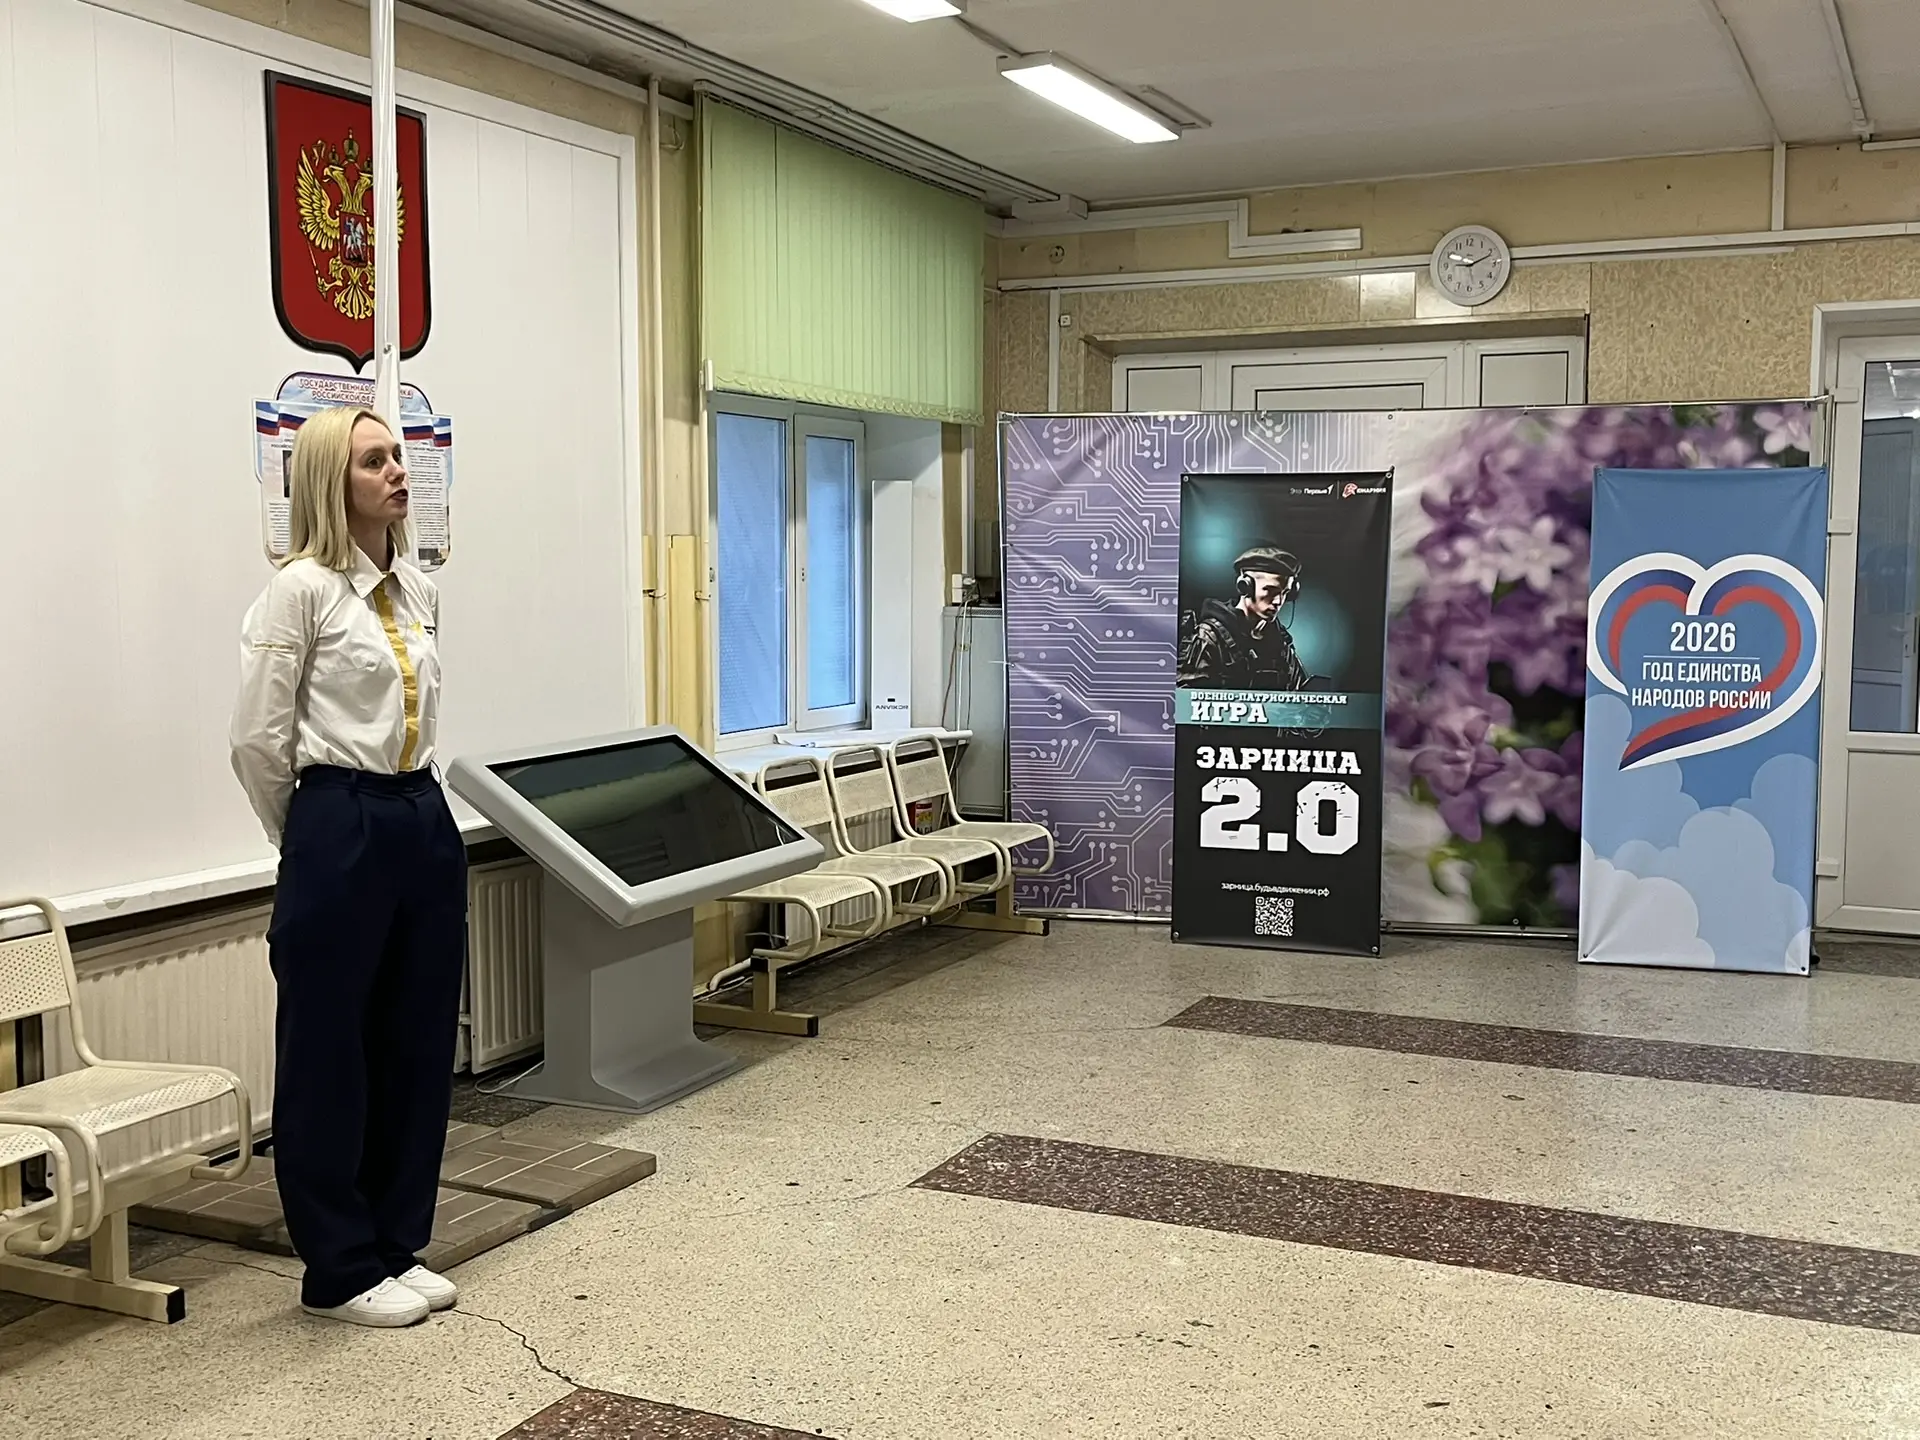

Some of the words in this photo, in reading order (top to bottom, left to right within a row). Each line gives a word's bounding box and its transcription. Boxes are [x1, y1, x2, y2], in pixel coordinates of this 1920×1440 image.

[299, 379, 369, 394] ГОСУДАРСТВЕННАЯ
[312, 390, 360, 401] РОССИЙСКОЙ
[1670, 621, 1736, 653] 2026
[1642, 662, 1674, 683] ГОД
[1678, 662, 1762, 683] ЕДИНСТВА
[1190, 691, 1348, 705] ВОЕННО-ПАТРИОТИЧЕСКАЯ
[1631, 687, 1705, 709] НАРОДОВ
[1709, 690, 1771, 710] РОССИИ
[1190, 702, 1268, 723] ИГРА
[1196, 746, 1362, 775] ЗАРНИЦА
[1200, 776, 1360, 855] 2.0
[1221, 882, 1330, 897] зарница.будьвдвижении.рф
